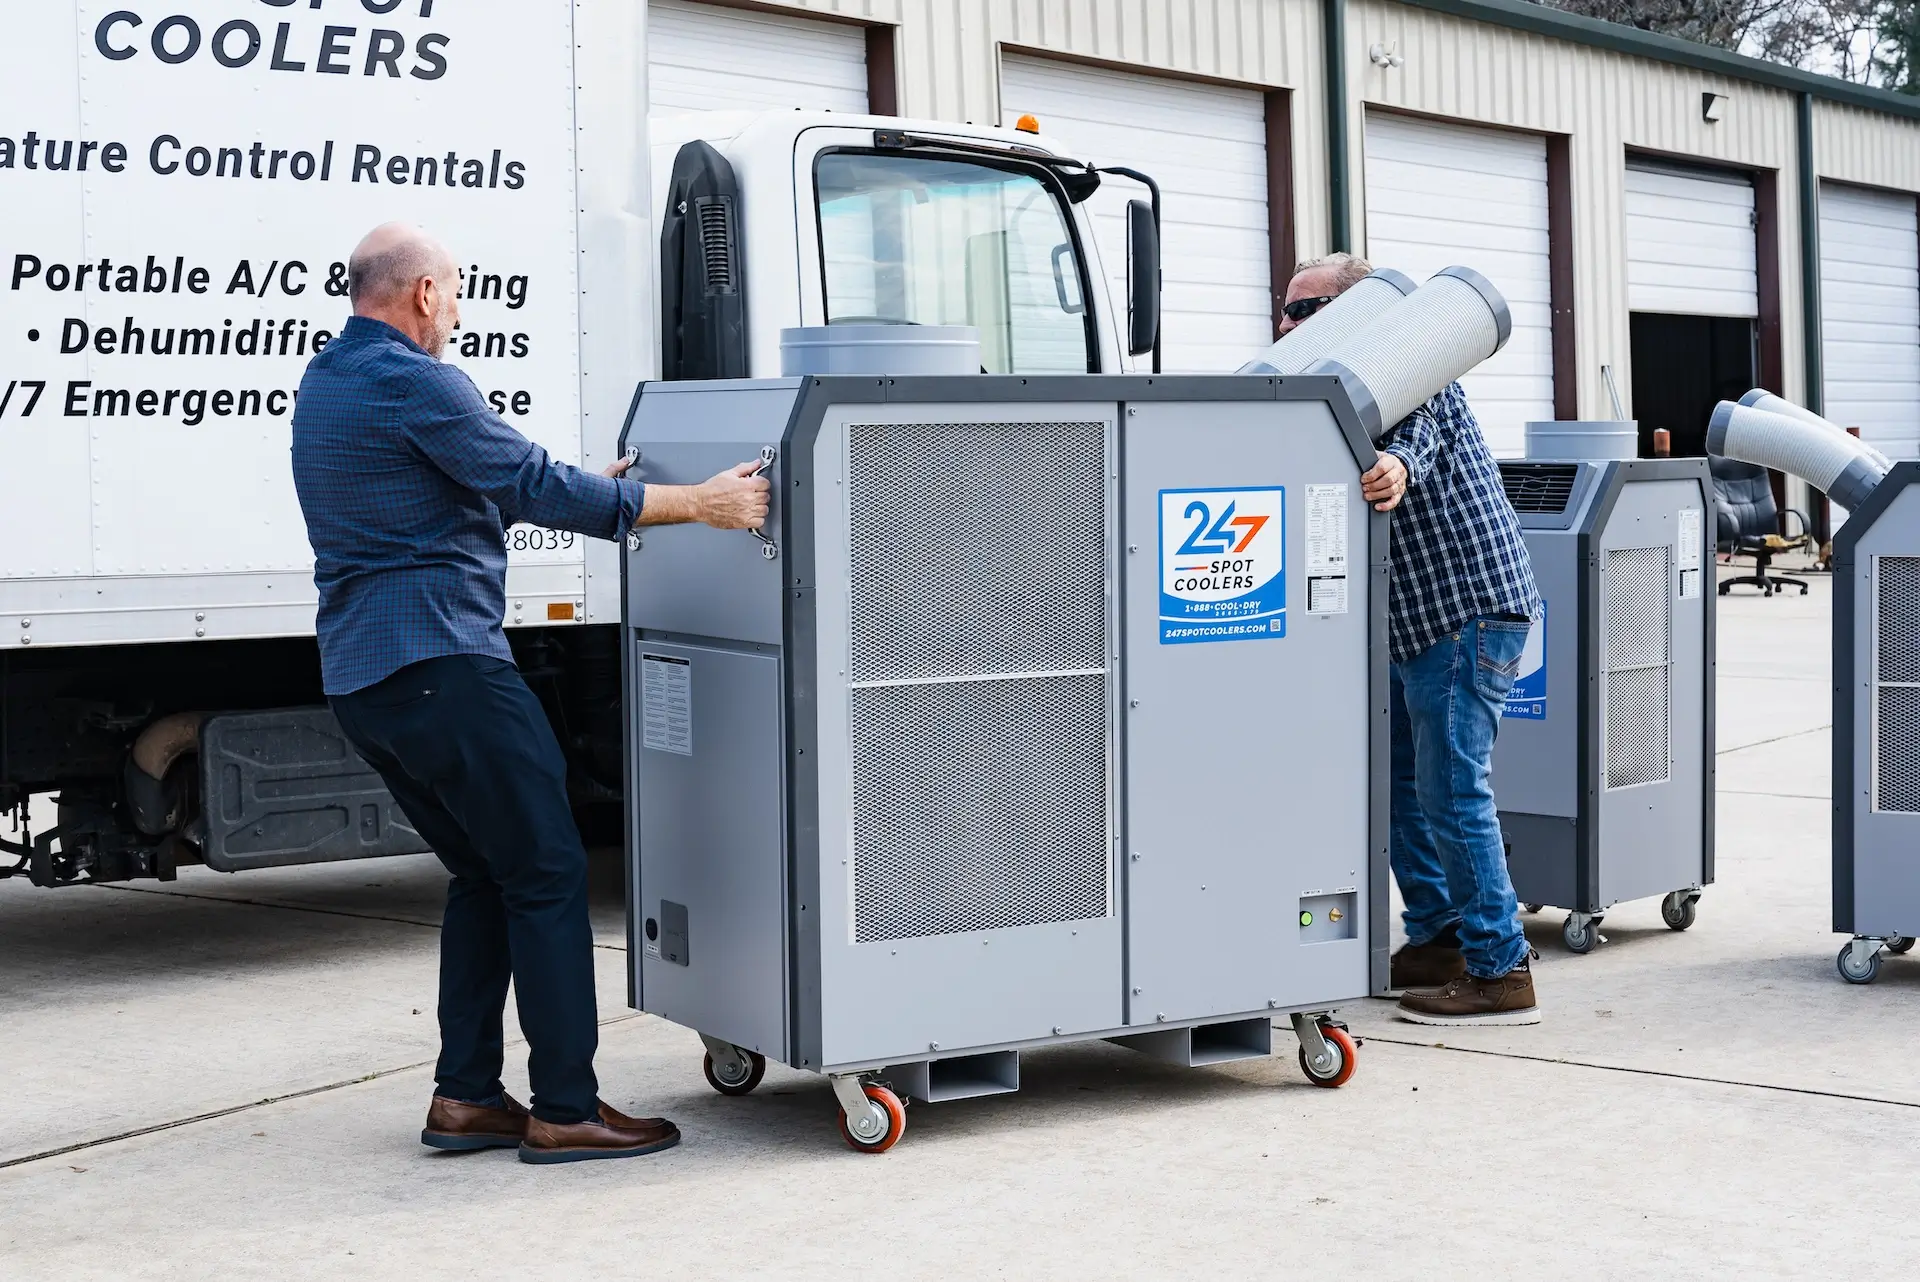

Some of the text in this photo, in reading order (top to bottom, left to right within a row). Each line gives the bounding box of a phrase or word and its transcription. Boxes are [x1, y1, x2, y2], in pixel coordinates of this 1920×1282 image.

[95, 11, 450, 80] COOLERS
[0, 131, 526, 190] ature Control Rentals
[11, 254, 210, 294] Portable
[225, 259, 308, 298] A/C
[324, 262, 350, 297] &
[60, 316, 343, 356] Dehumidifie
[1175, 499, 1271, 555] 247
[1174, 575, 1254, 592] COOLERS
[1210, 559, 1254, 574] SPOT
[1165, 624, 1267, 639] 247SPOTCOOLERS.COM
